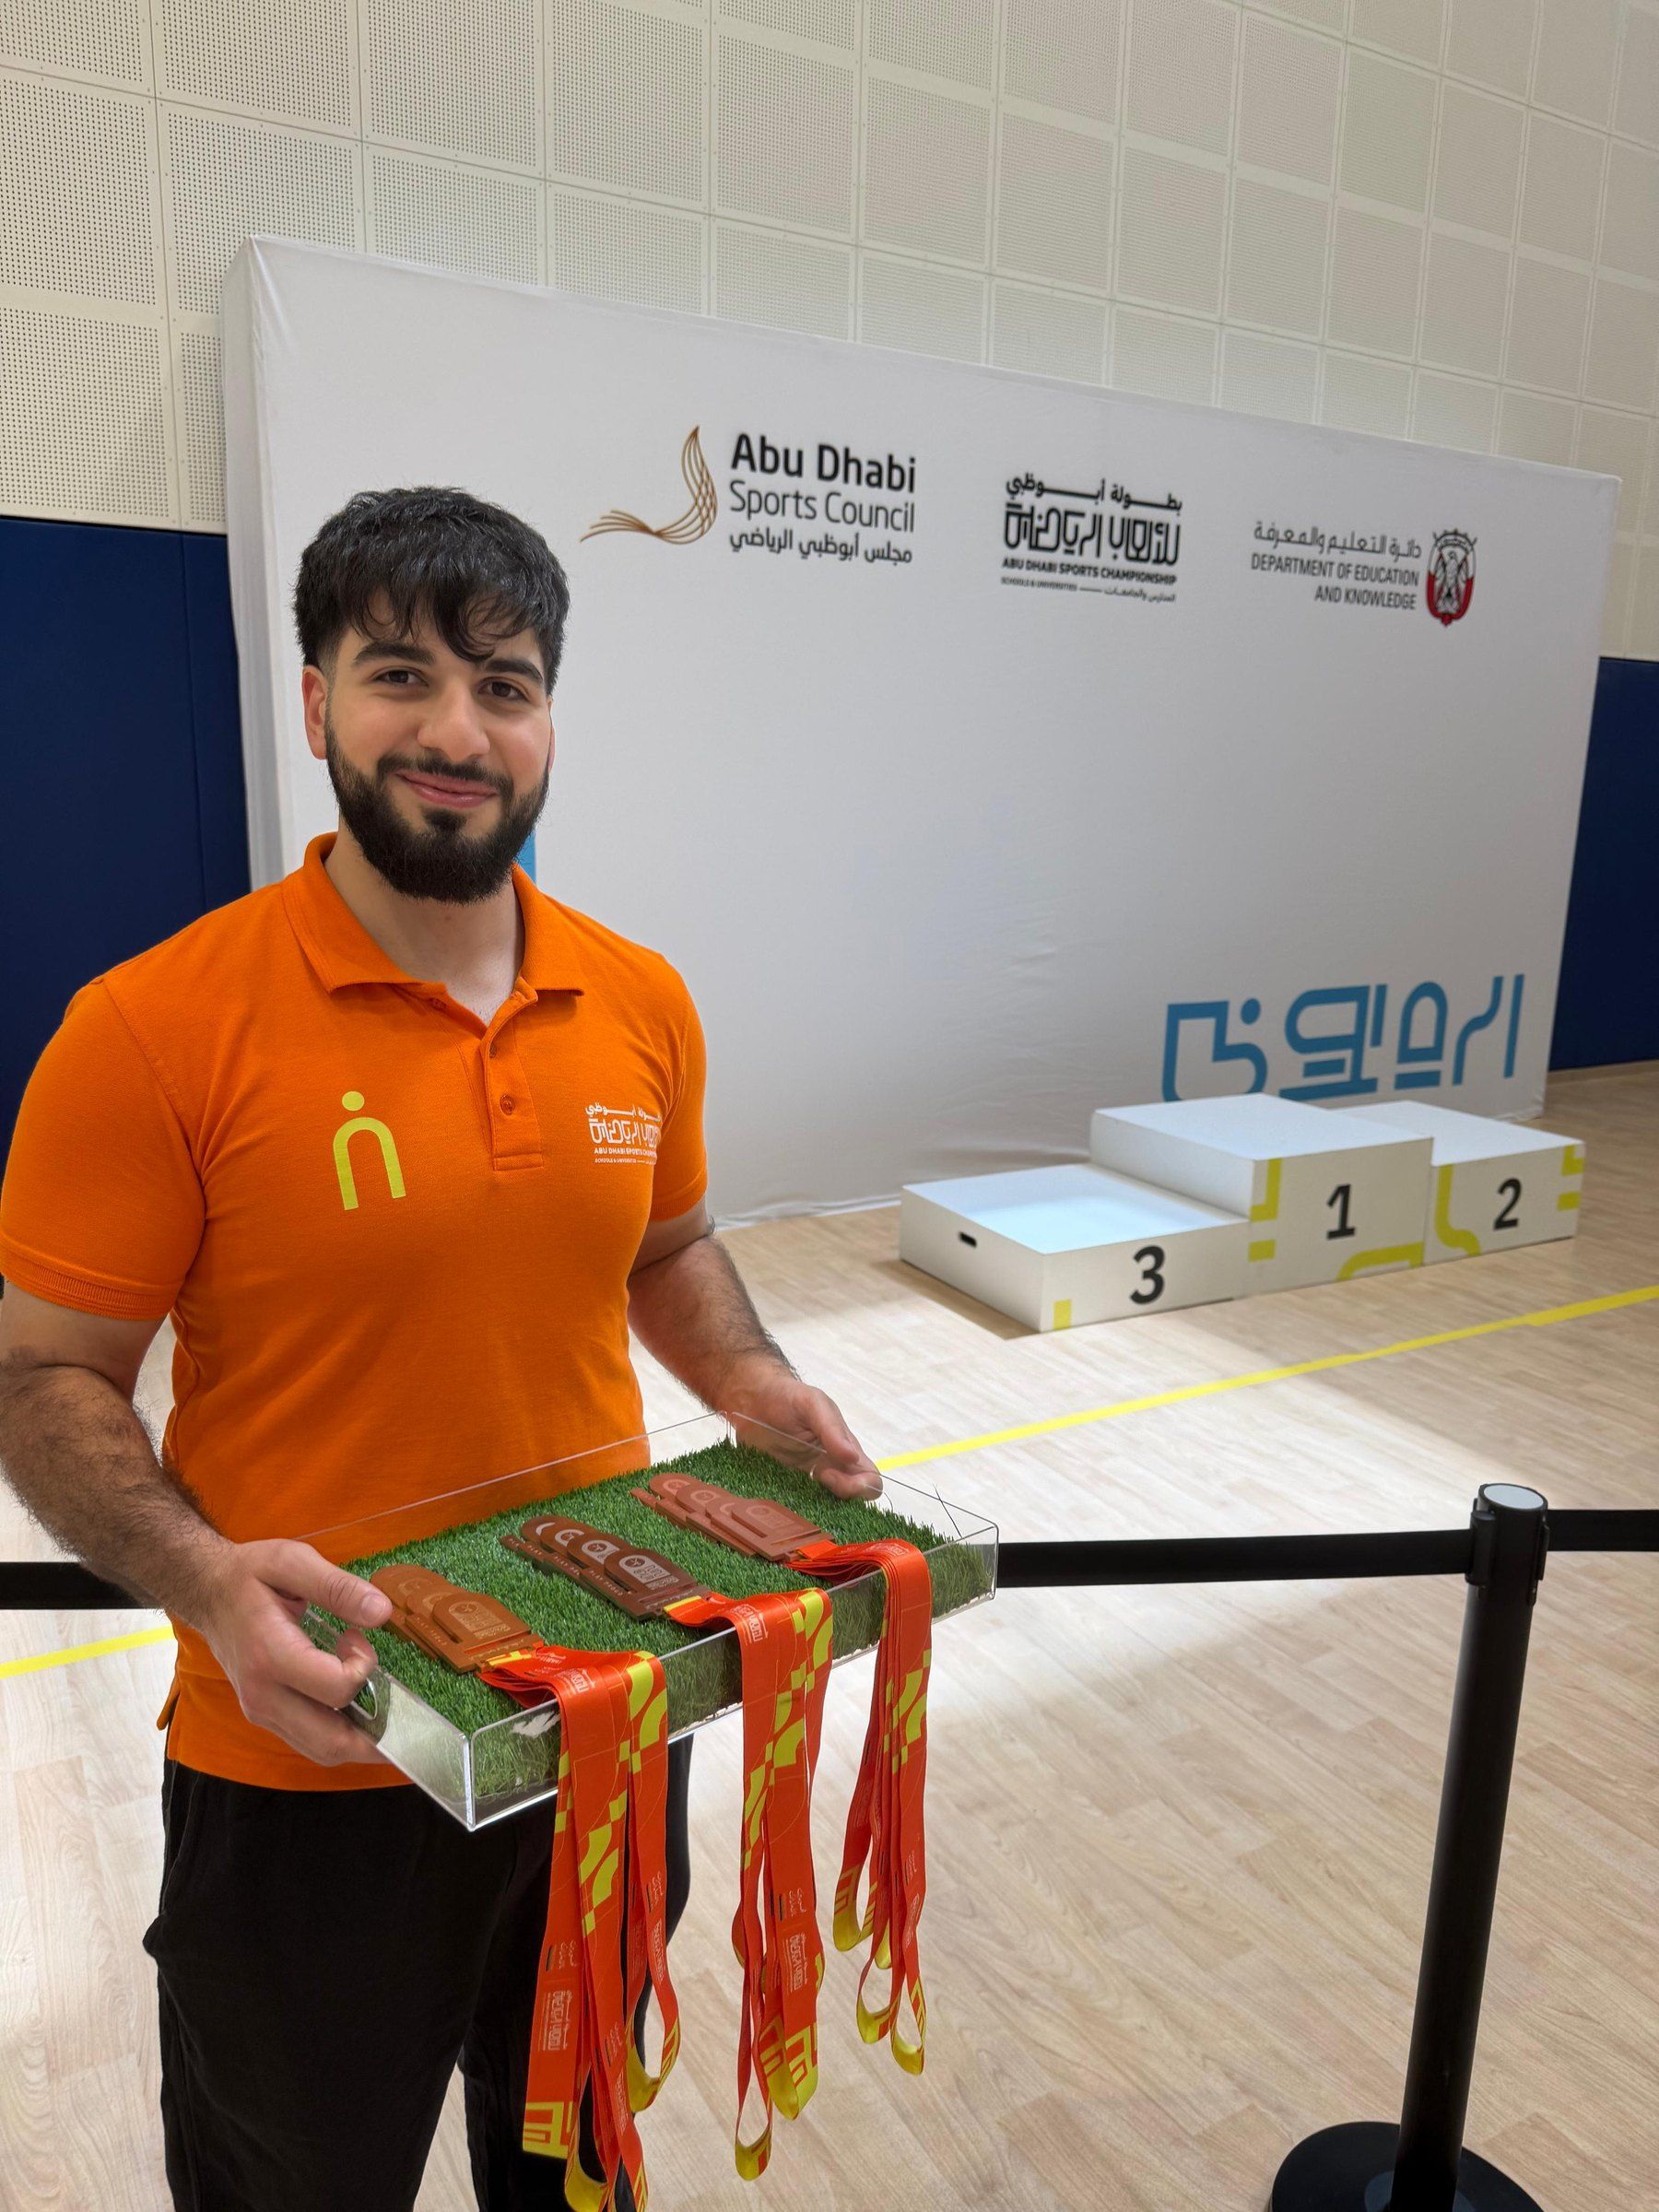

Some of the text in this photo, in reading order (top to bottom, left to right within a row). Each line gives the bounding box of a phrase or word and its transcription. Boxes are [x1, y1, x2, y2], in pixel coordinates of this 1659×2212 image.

[731, 433, 916, 494] Abu Dhabi
[729, 479, 915, 533] Sports Council
[730, 527, 913, 564] مجلس أبوظبي الرياضي
[1002, 557, 1178, 586] ABU DHABI SPORTS CHAMPIONSHIP
[1251, 553, 1420, 587] DEPARTMENT OF EDUCATION
[1314, 585, 1418, 610] AND KNOWLEDGE
[1326, 1183, 1356, 1239] 1
[1493, 1178, 1522, 1230] 2
[1129, 1245, 1166, 1304] 3
